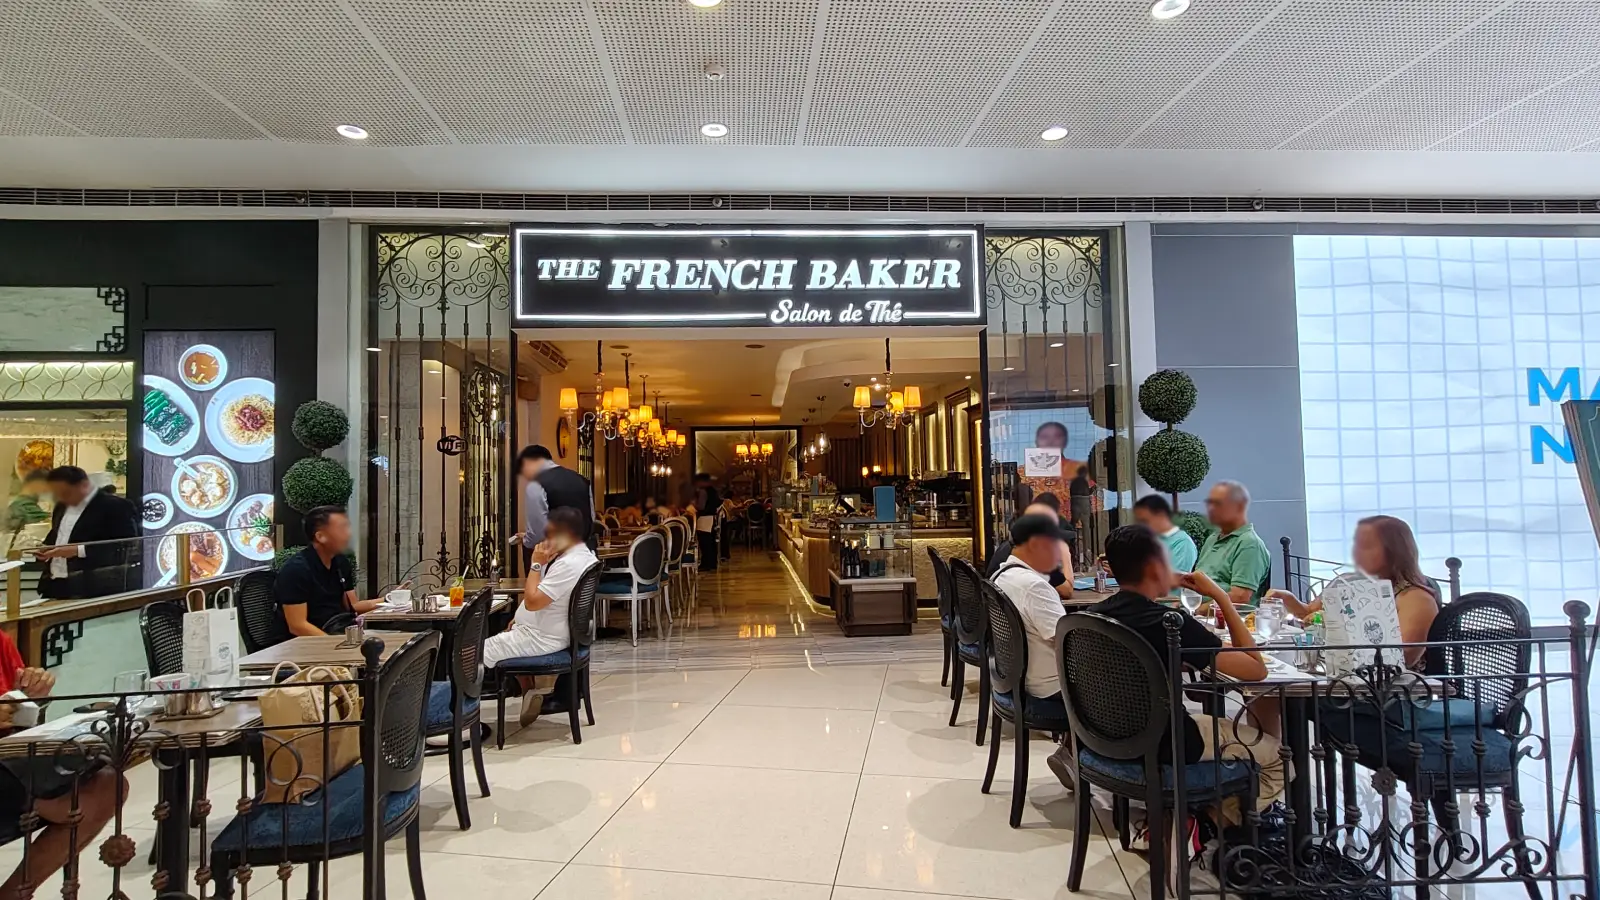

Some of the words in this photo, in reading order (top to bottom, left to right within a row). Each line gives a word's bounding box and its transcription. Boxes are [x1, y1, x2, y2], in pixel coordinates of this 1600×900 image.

[537, 259, 600, 280] THE
[607, 259, 798, 290] FRENCH
[805, 259, 961, 289] BAKER
[770, 299, 832, 324] Salon
[839, 303, 863, 323] de
[864, 300, 903, 324] Thé
[1527, 367, 1600, 406] M
